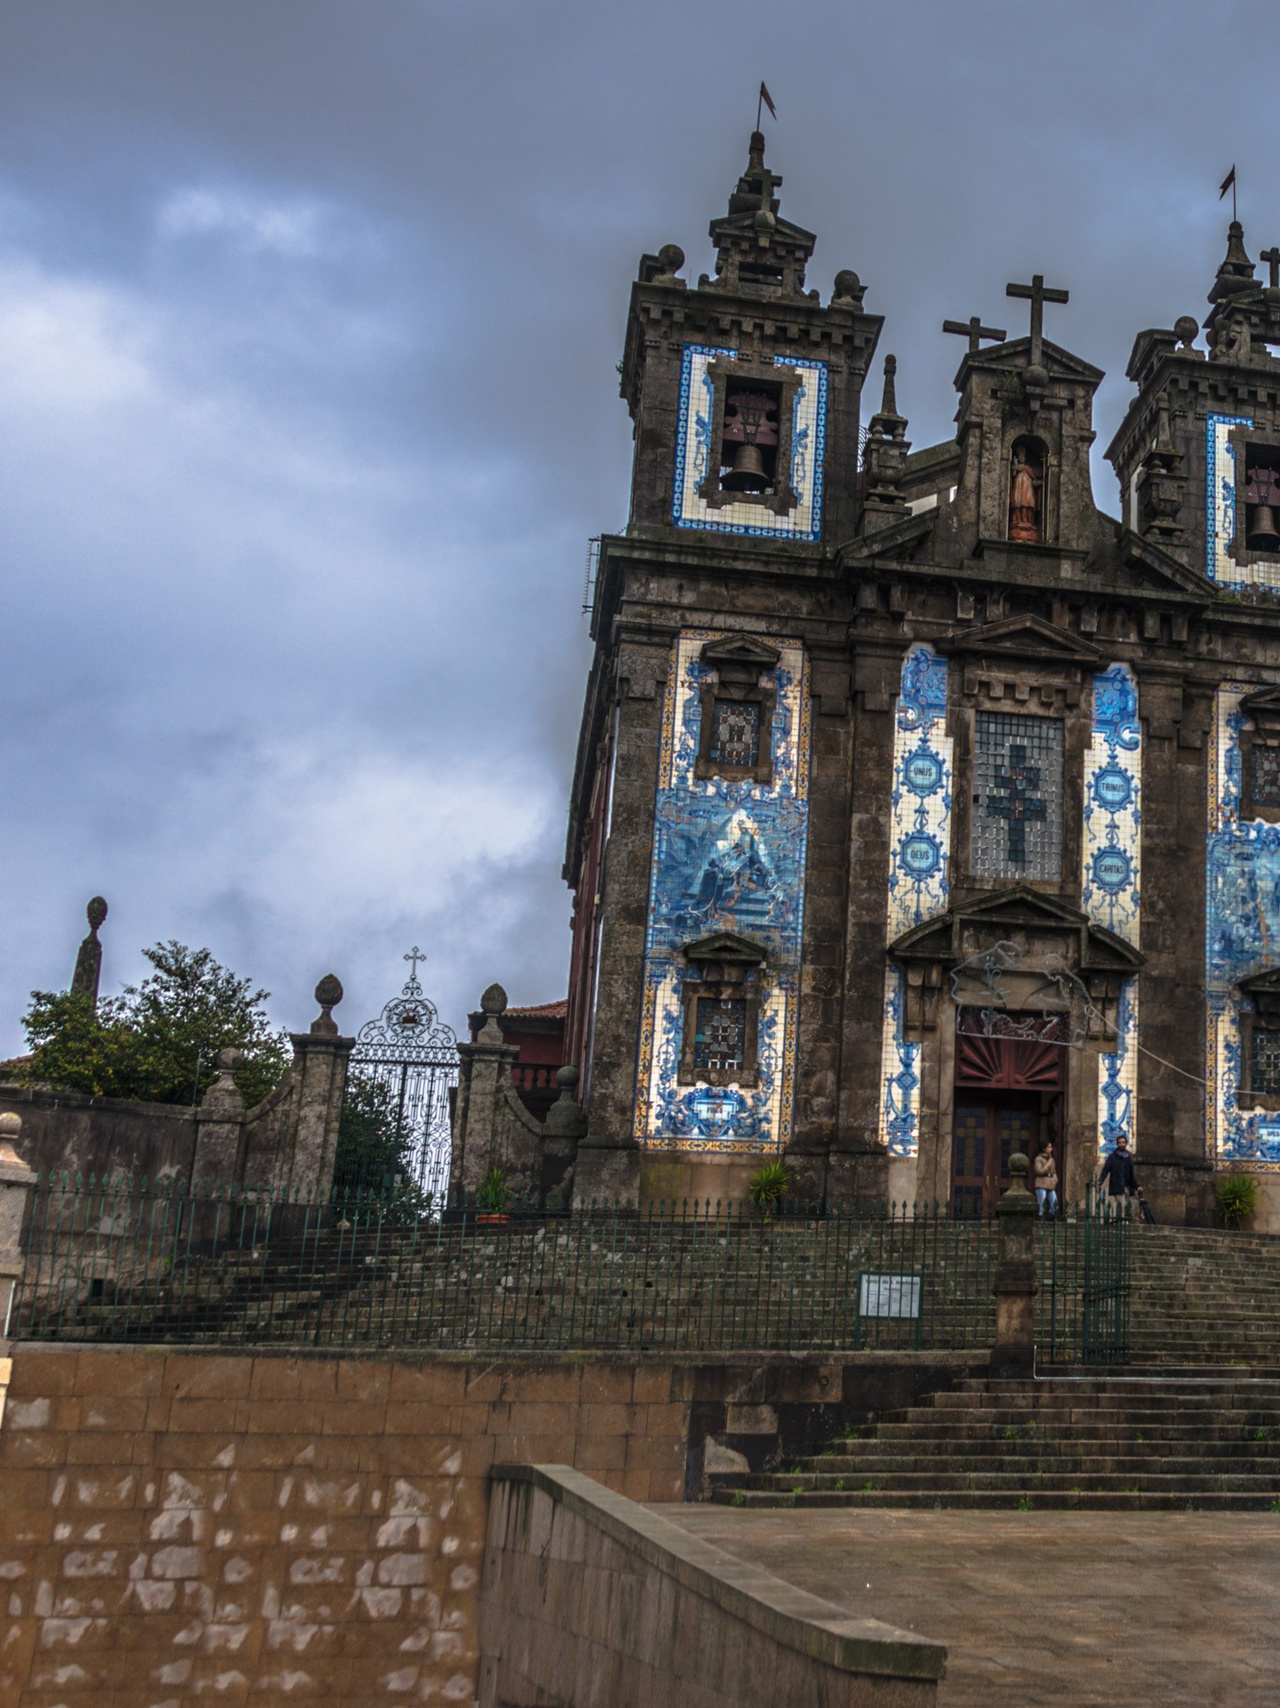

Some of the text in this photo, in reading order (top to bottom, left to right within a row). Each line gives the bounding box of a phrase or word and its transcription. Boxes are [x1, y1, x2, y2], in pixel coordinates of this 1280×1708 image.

[913, 766, 933, 777] UNUS
[1101, 782, 1125, 793] TRINUS
[910, 849, 930, 860] DEUS
[1100, 864, 1124, 874] CARITAS
